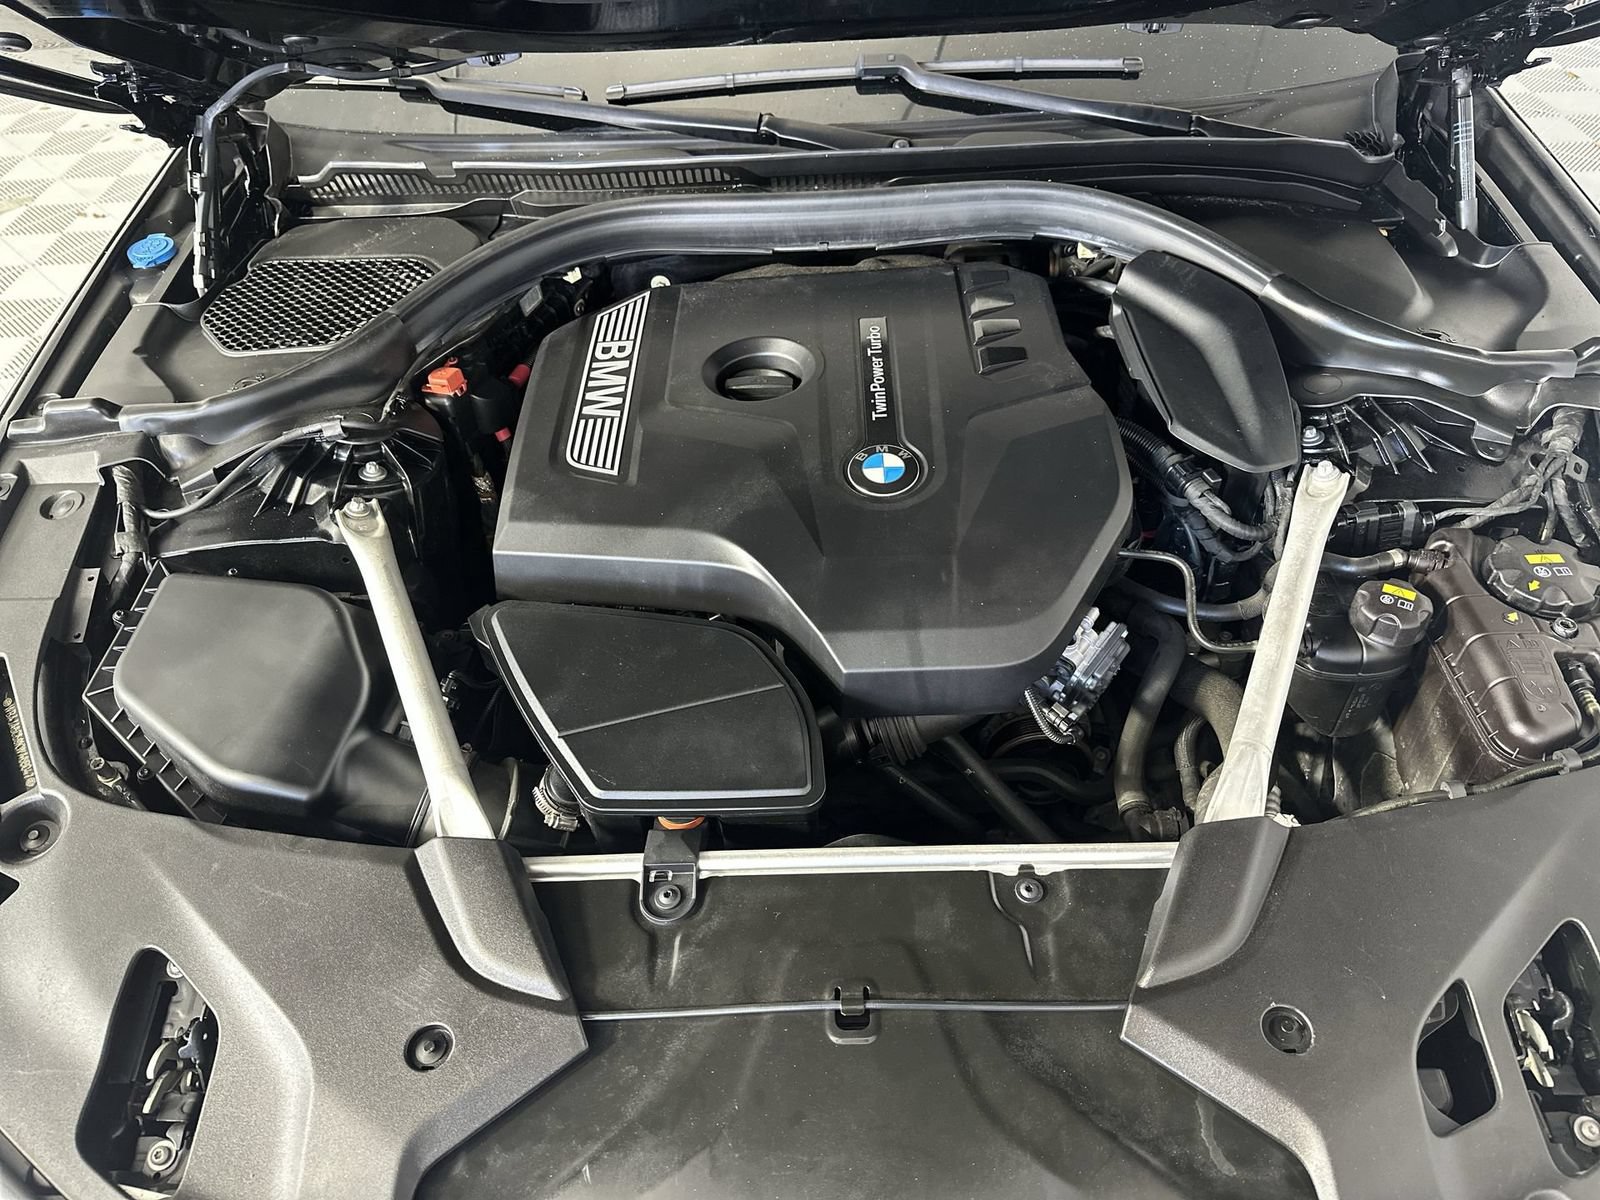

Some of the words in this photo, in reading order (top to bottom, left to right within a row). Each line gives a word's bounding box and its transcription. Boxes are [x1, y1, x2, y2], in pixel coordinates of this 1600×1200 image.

[866, 325, 883, 356] Turbo
[581, 340, 634, 417] BMW
[871, 356, 888, 421] TwinPower
